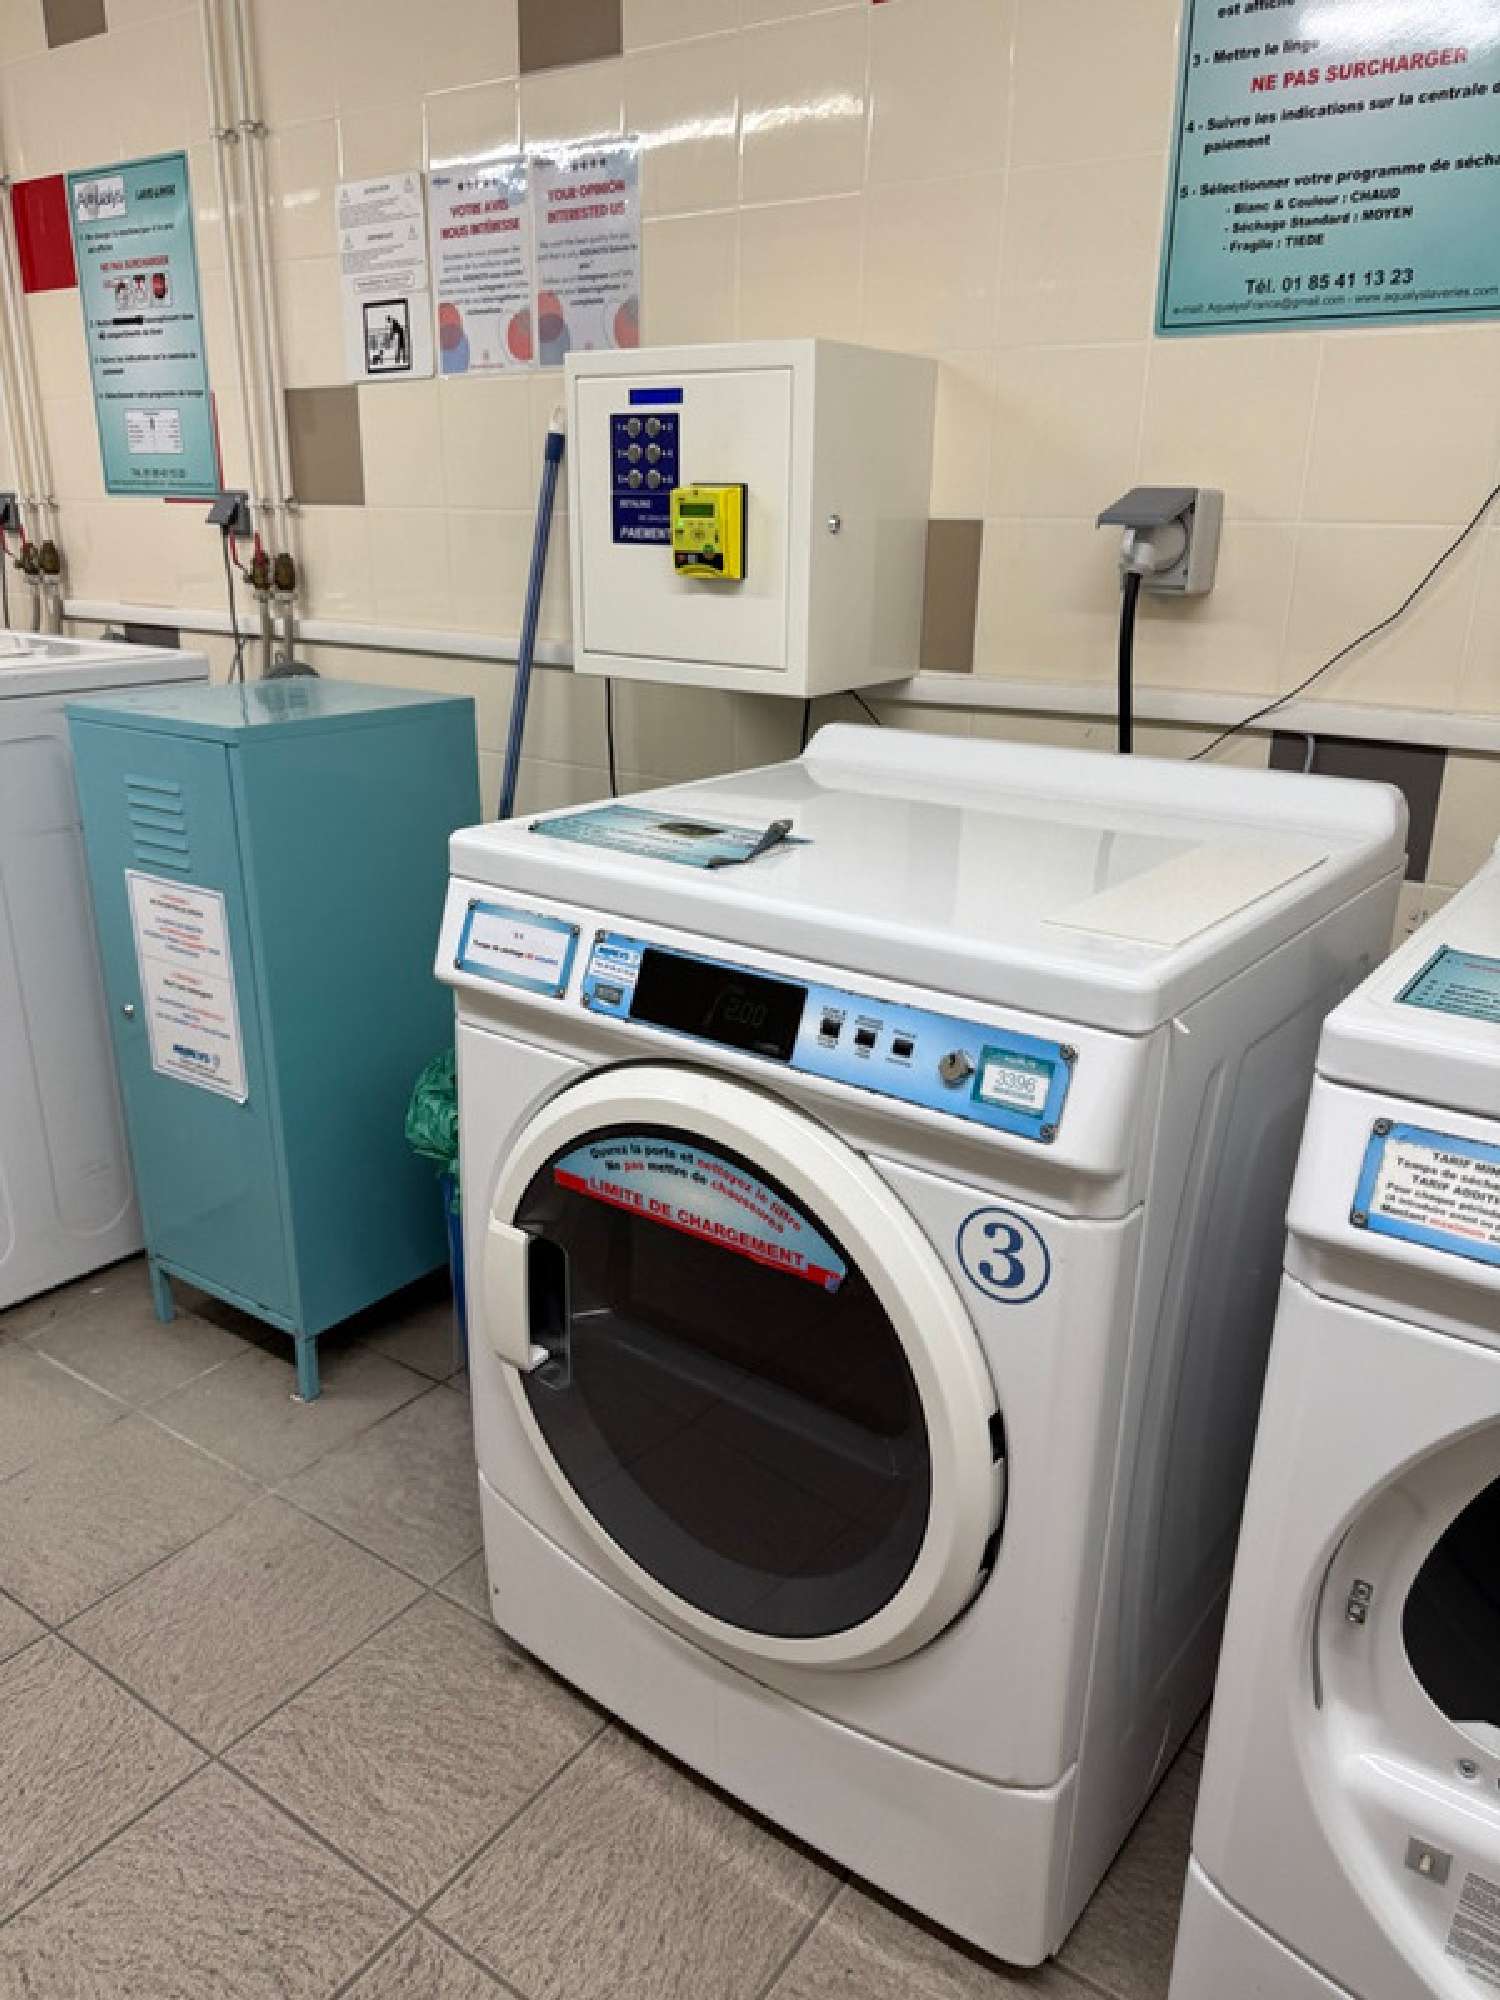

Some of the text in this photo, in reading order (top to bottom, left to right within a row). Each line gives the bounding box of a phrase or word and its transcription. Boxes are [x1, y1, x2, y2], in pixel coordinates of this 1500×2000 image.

[1213, 47, 1260, 63] Mettre
[1265, 42, 1279, 55] le
[1250, 47, 1469, 93] NE PAS SURCHARGER
[1185, 119, 1194, 133] 4
[1206, 116, 1251, 131] Suivre
[1255, 112, 1276, 126] les
[1280, 100, 1365, 122] indications
[1369, 97, 1395, 111] sur
[1399, 92, 1413, 105] la
[1418, 82, 1489, 104] centrale
[1204, 133, 1271, 155] paiement
[1180, 184, 1188, 199] 5
[1294, 172, 1334, 186] votre
[1336, 162, 1427, 185] programme
[1430, 157, 1450, 172] de
[1288, 194, 1339, 210] Couleur
[1350, 186, 1401, 204] CHAUD
[1290, 212, 1351, 229] Standard
[1362, 204, 1414, 221] MOYEN
[1229, 239, 1273, 254] Fragile
[1282, 275, 1302, 294] 01
[1308, 272, 1331, 291] 85
[1334, 272, 1356, 289] 41
[1364, 269, 1386, 286] 13
[1390, 266, 1415, 286] 23
[589, 1142, 802, 1232] Ouvrez la porte et nettoyez le filtre
[605, 1161, 785, 1234] Ne pas mettre de chaussures
[589, 1175, 806, 1267] LIMITE DE CHARGEMENT
[978, 1221, 1026, 1289] 3
